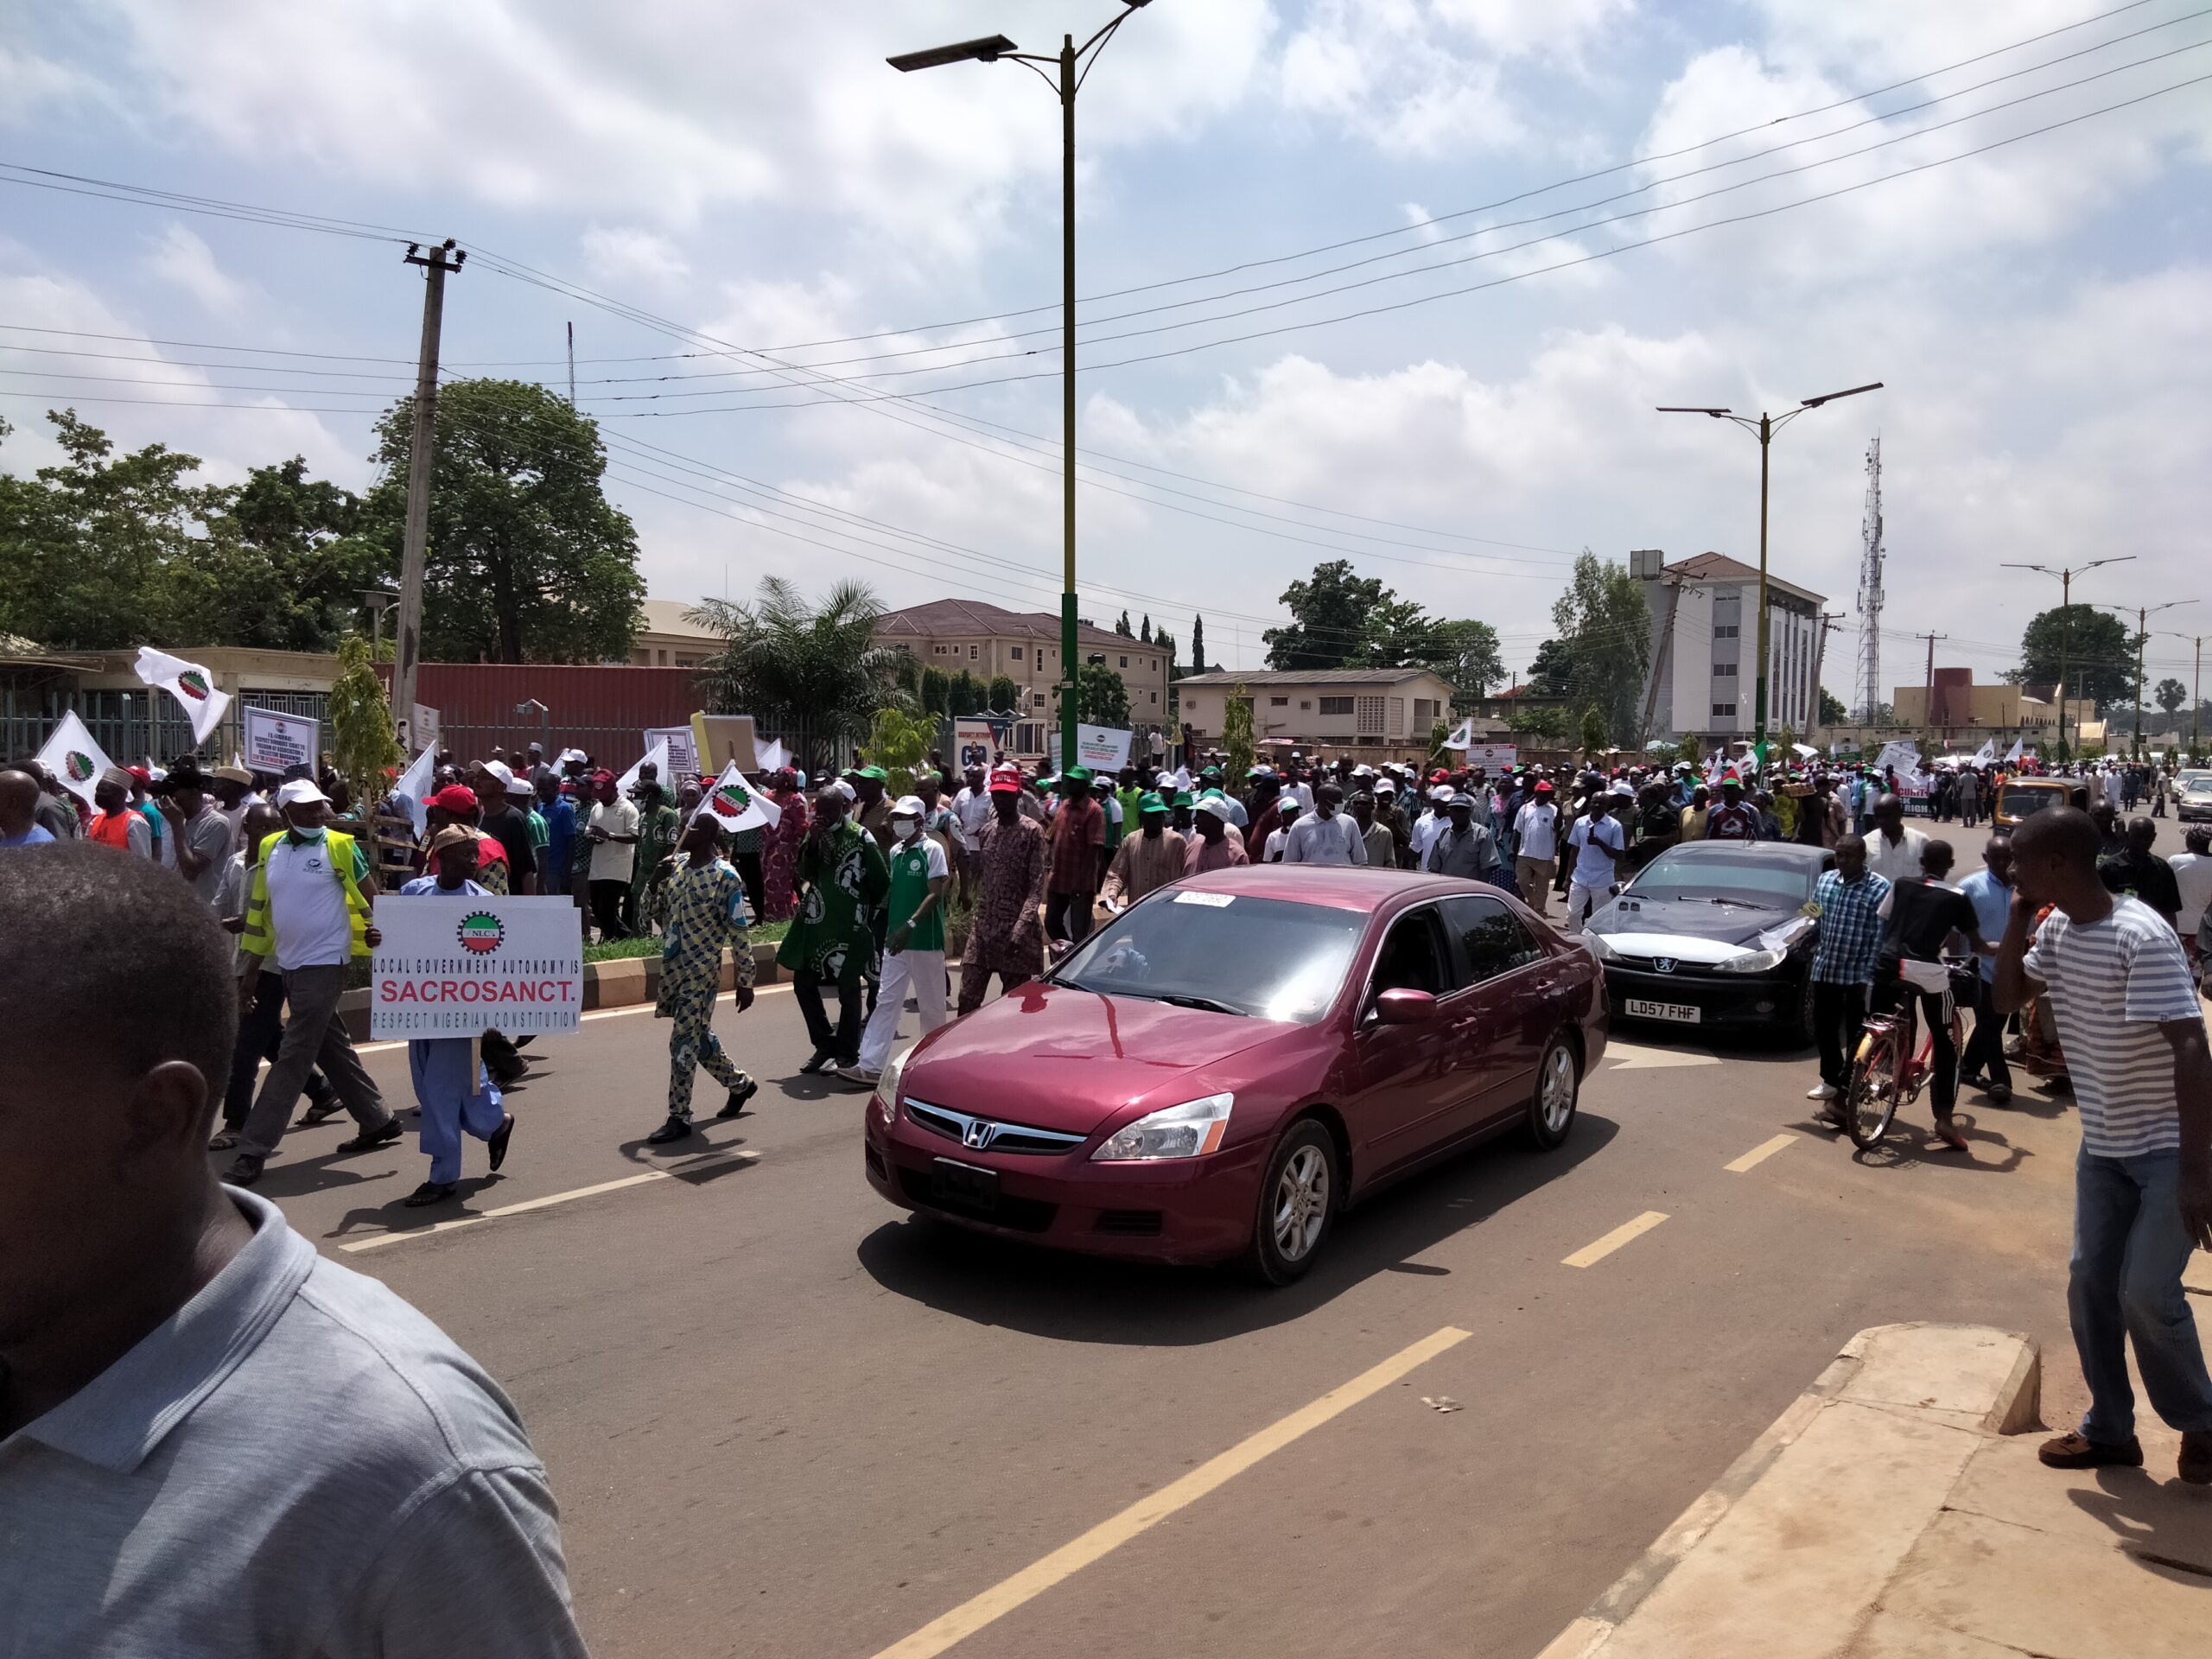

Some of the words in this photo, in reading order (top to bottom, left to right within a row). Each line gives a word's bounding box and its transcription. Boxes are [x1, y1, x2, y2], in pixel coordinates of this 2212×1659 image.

[723, 797, 738, 807] NLC
[373, 959, 410, 974] LOCAL
[416, 959, 496, 974] GOVERNMENT
[503, 960, 566, 975] AUTONOMY
[570, 959, 579, 975] IS
[380, 980, 576, 1003] SACROSANCT.
[1630, 1001, 1665, 1017] LD57
[1669, 1006, 1695, 1020] FHF
[372, 1012, 429, 1029] RESPECT
[433, 1012, 488, 1029] NIGERIAN
[495, 1011, 578, 1028] CONSTITUTION
